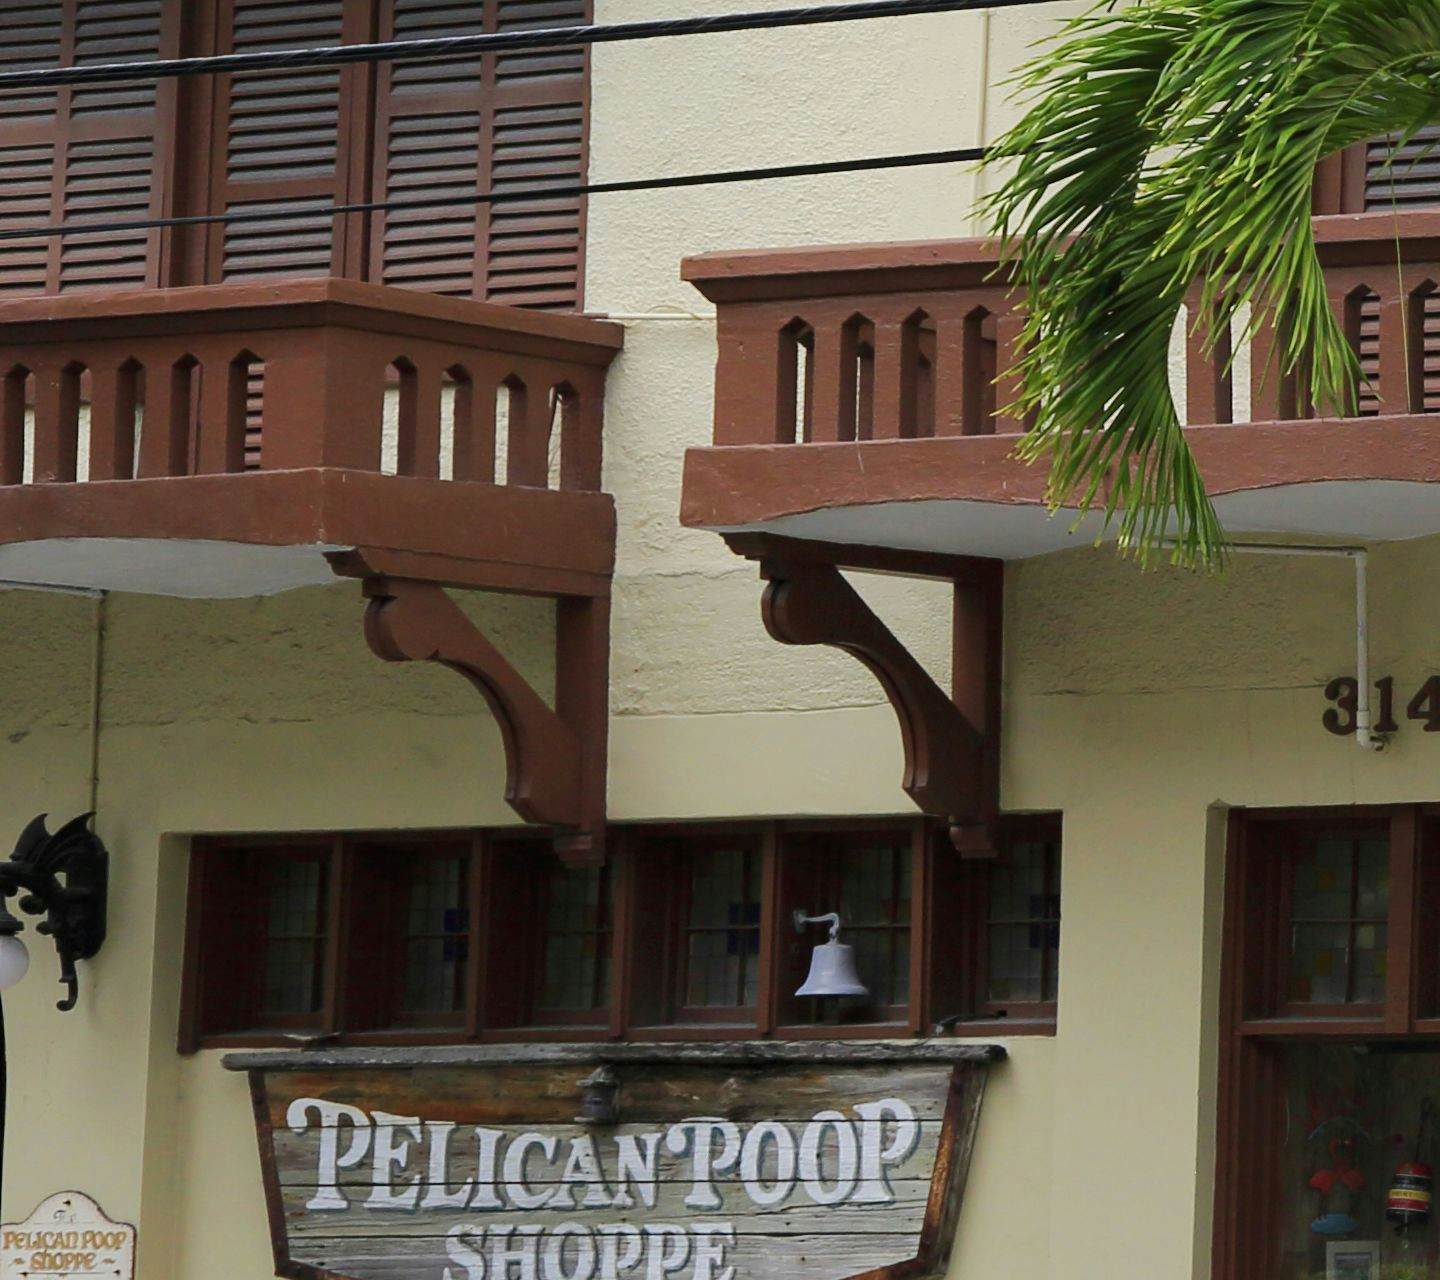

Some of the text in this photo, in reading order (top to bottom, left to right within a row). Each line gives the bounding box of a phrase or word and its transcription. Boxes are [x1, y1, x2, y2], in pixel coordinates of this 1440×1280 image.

[286, 1097, 920, 1211] PELICAN POOP
[3, 1230, 127, 1251] PELICAN POOP
